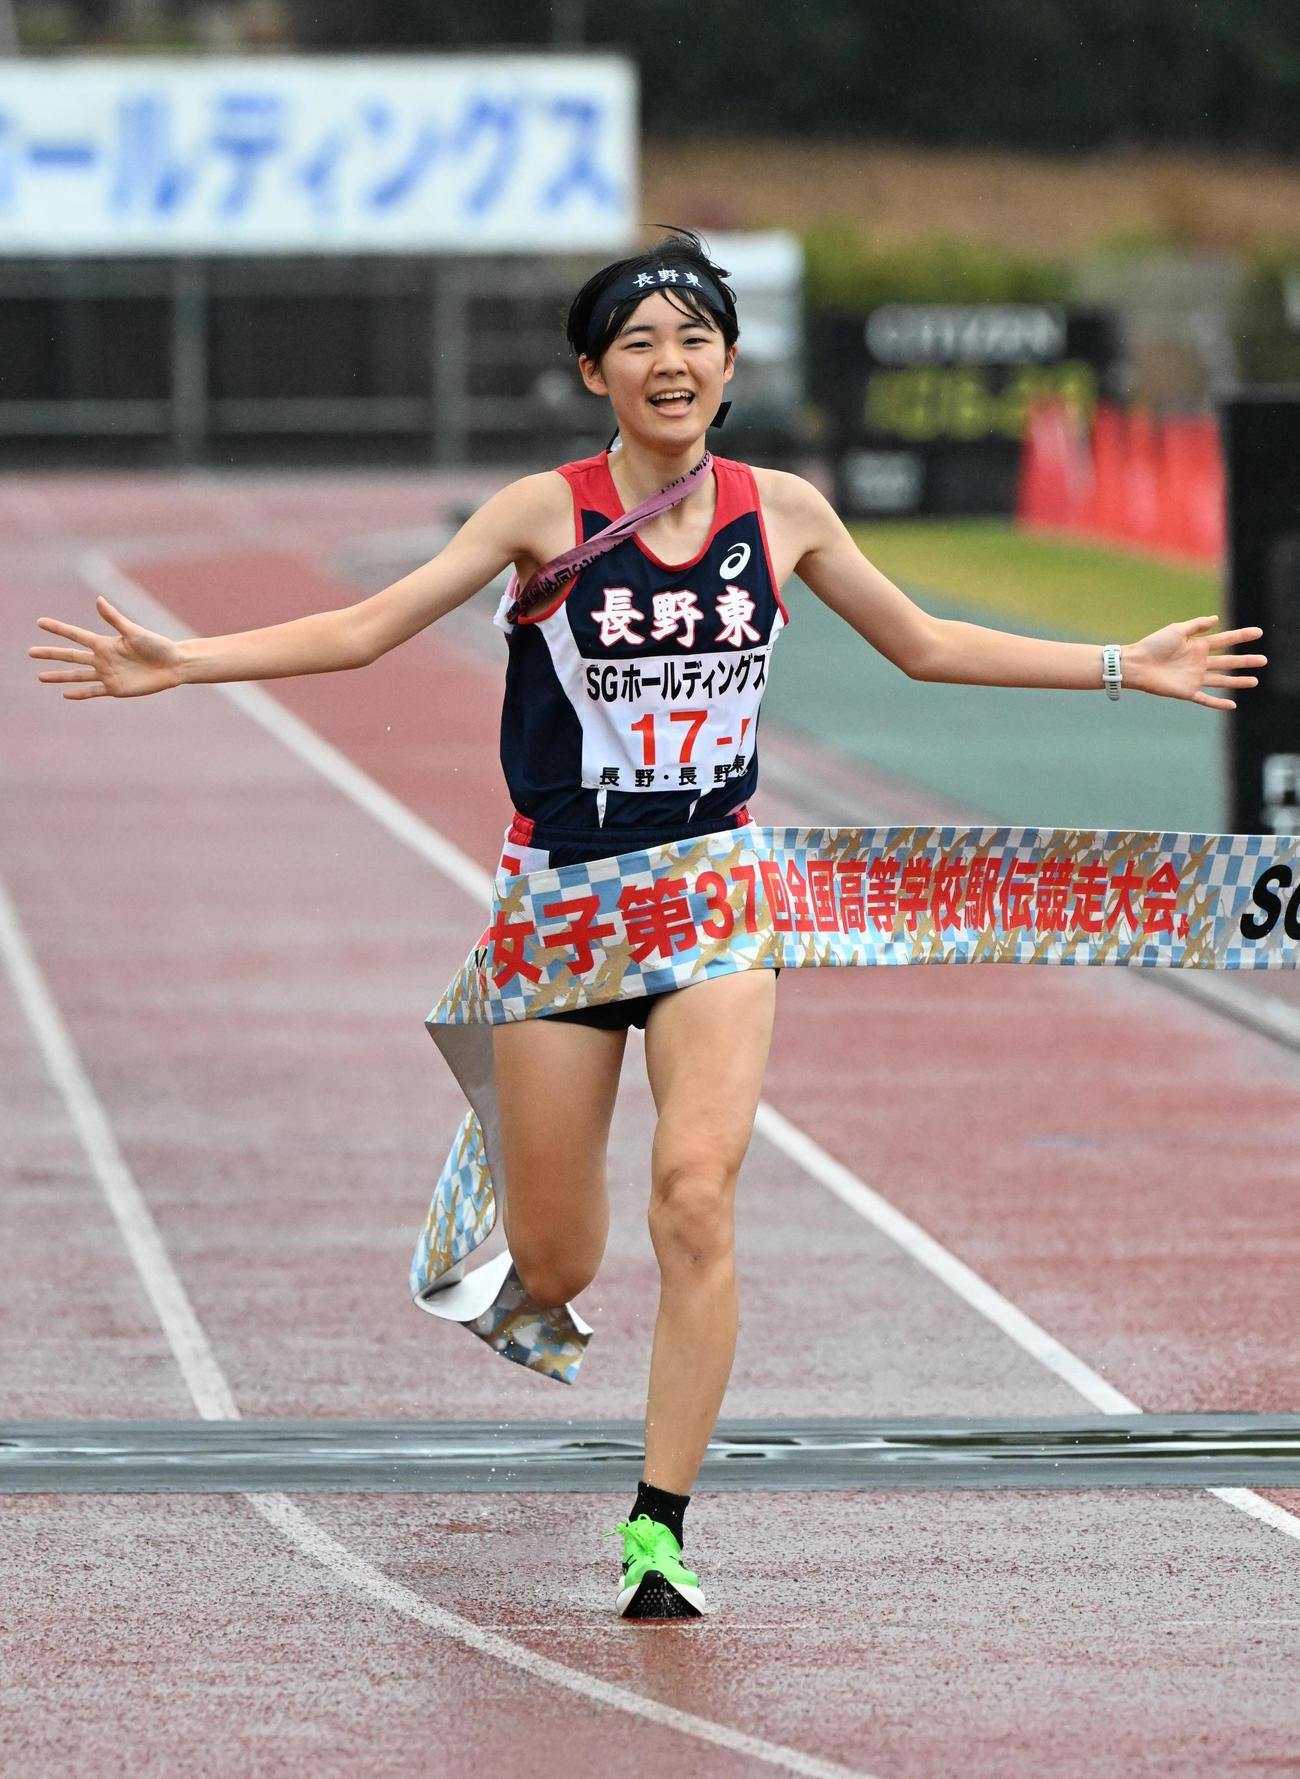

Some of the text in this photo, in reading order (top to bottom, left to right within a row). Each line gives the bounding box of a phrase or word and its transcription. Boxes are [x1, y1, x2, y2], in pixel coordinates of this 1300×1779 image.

[0, 88, 620, 215] ールディングス
[632, 268, 703, 288] 長野東
[590, 585, 761, 648] 長野東
[586, 653, 767, 702] SGホールディングス
[630, 709, 752, 766] 17-
